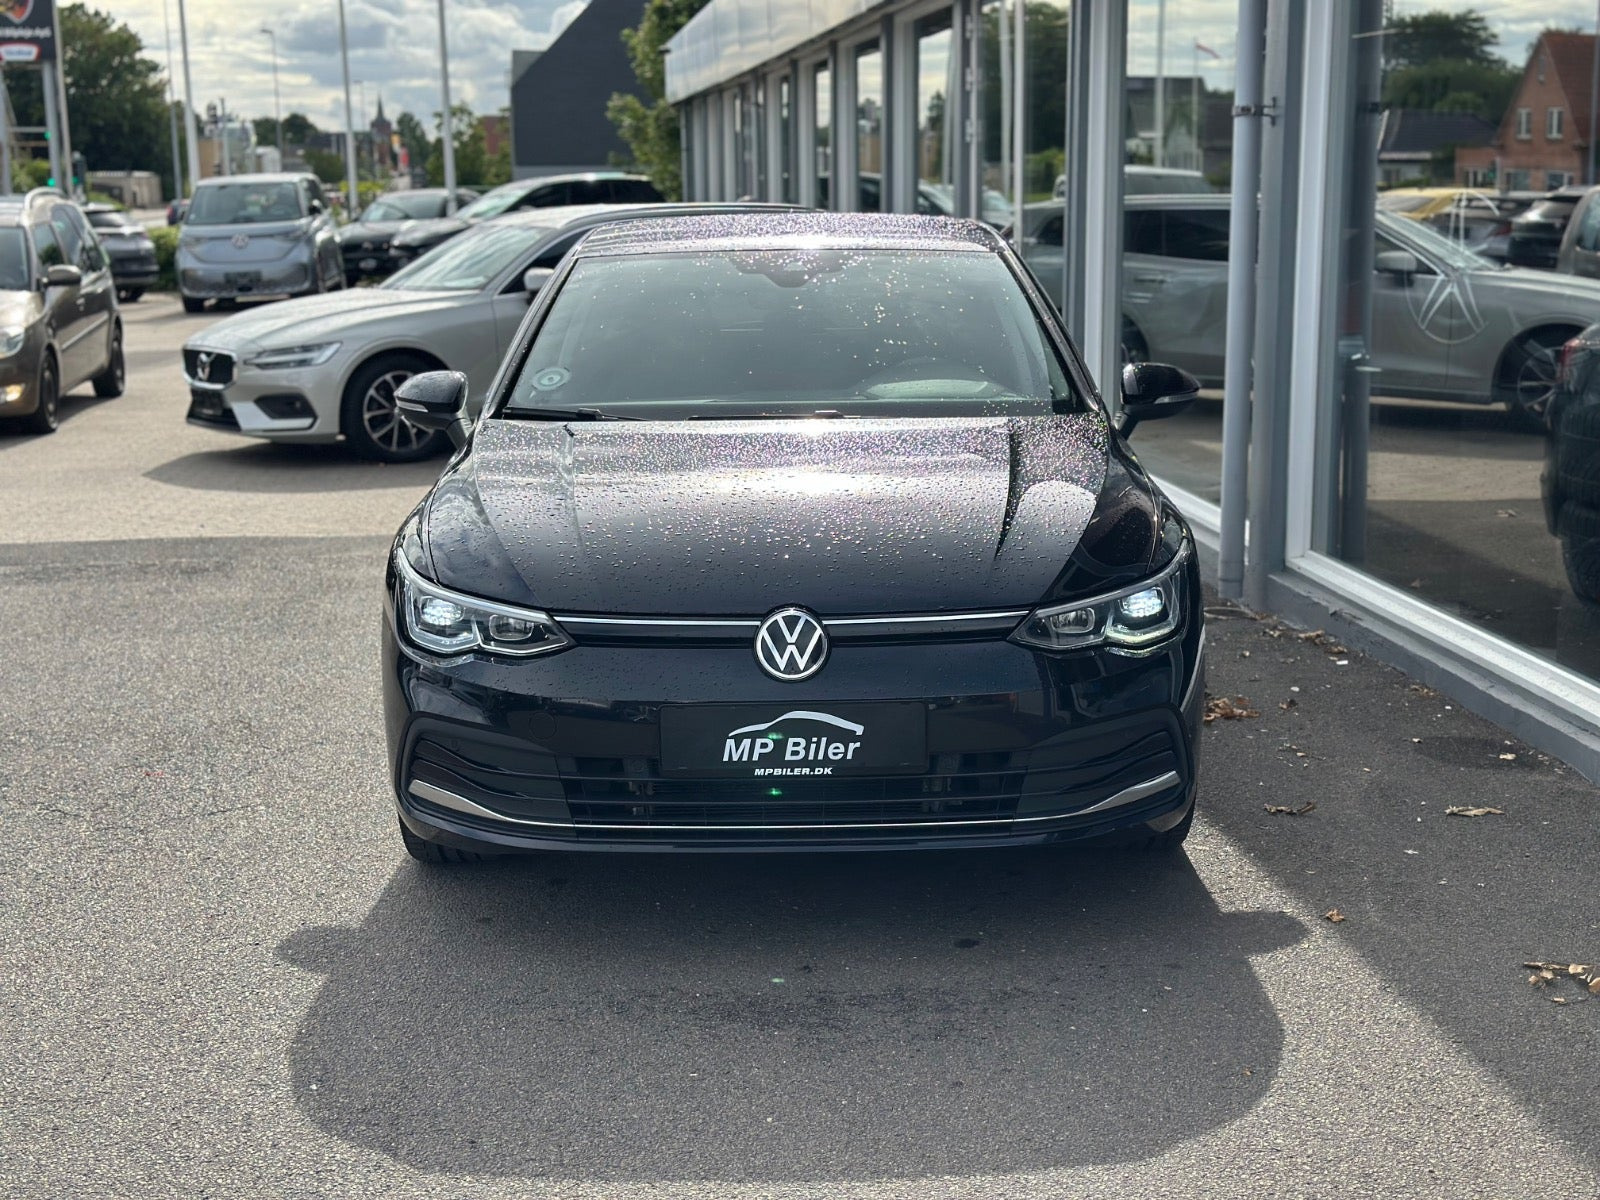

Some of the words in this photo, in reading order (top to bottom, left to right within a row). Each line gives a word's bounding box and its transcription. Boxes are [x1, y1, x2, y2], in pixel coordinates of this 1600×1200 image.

[760, 614, 825, 673] VW
[723, 738, 774, 762] MP
[785, 737, 861, 761] Biler
[754, 767, 833, 776] MPBILER.DK
